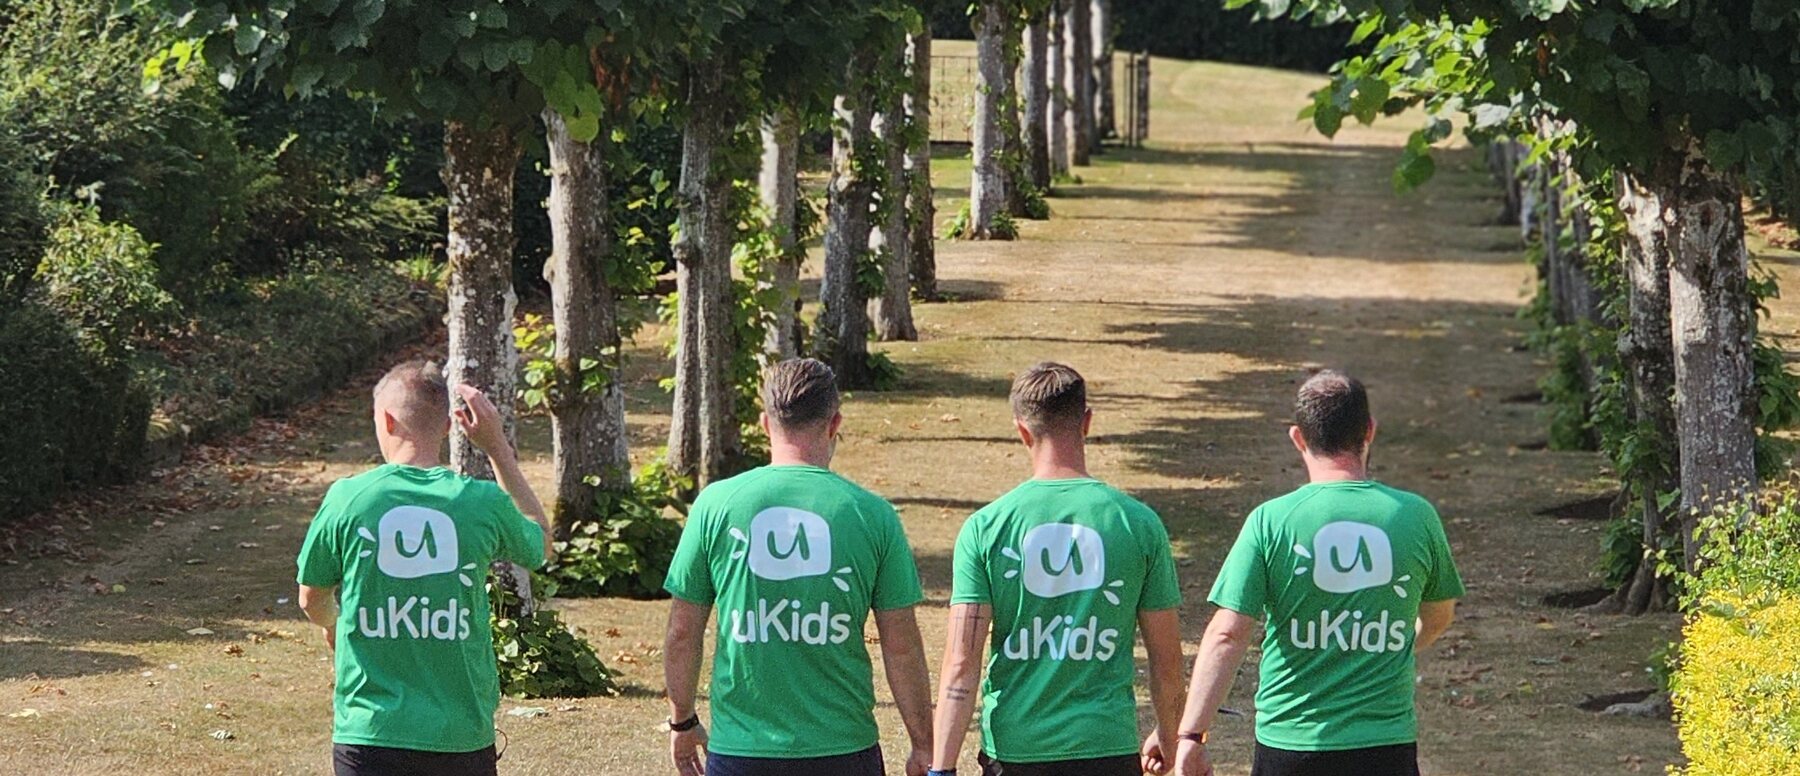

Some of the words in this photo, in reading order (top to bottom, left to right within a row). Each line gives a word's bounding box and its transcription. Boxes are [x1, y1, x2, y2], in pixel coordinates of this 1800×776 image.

[395, 521, 437, 559] u
[767, 523, 810, 560] u
[1041, 540, 1083, 576] u
[1330, 536, 1372, 573] u
[358, 597, 471, 641] uKids
[731, 599, 850, 645] uKids
[1003, 615, 1118, 661] uKids
[1290, 610, 1405, 652] uKids
